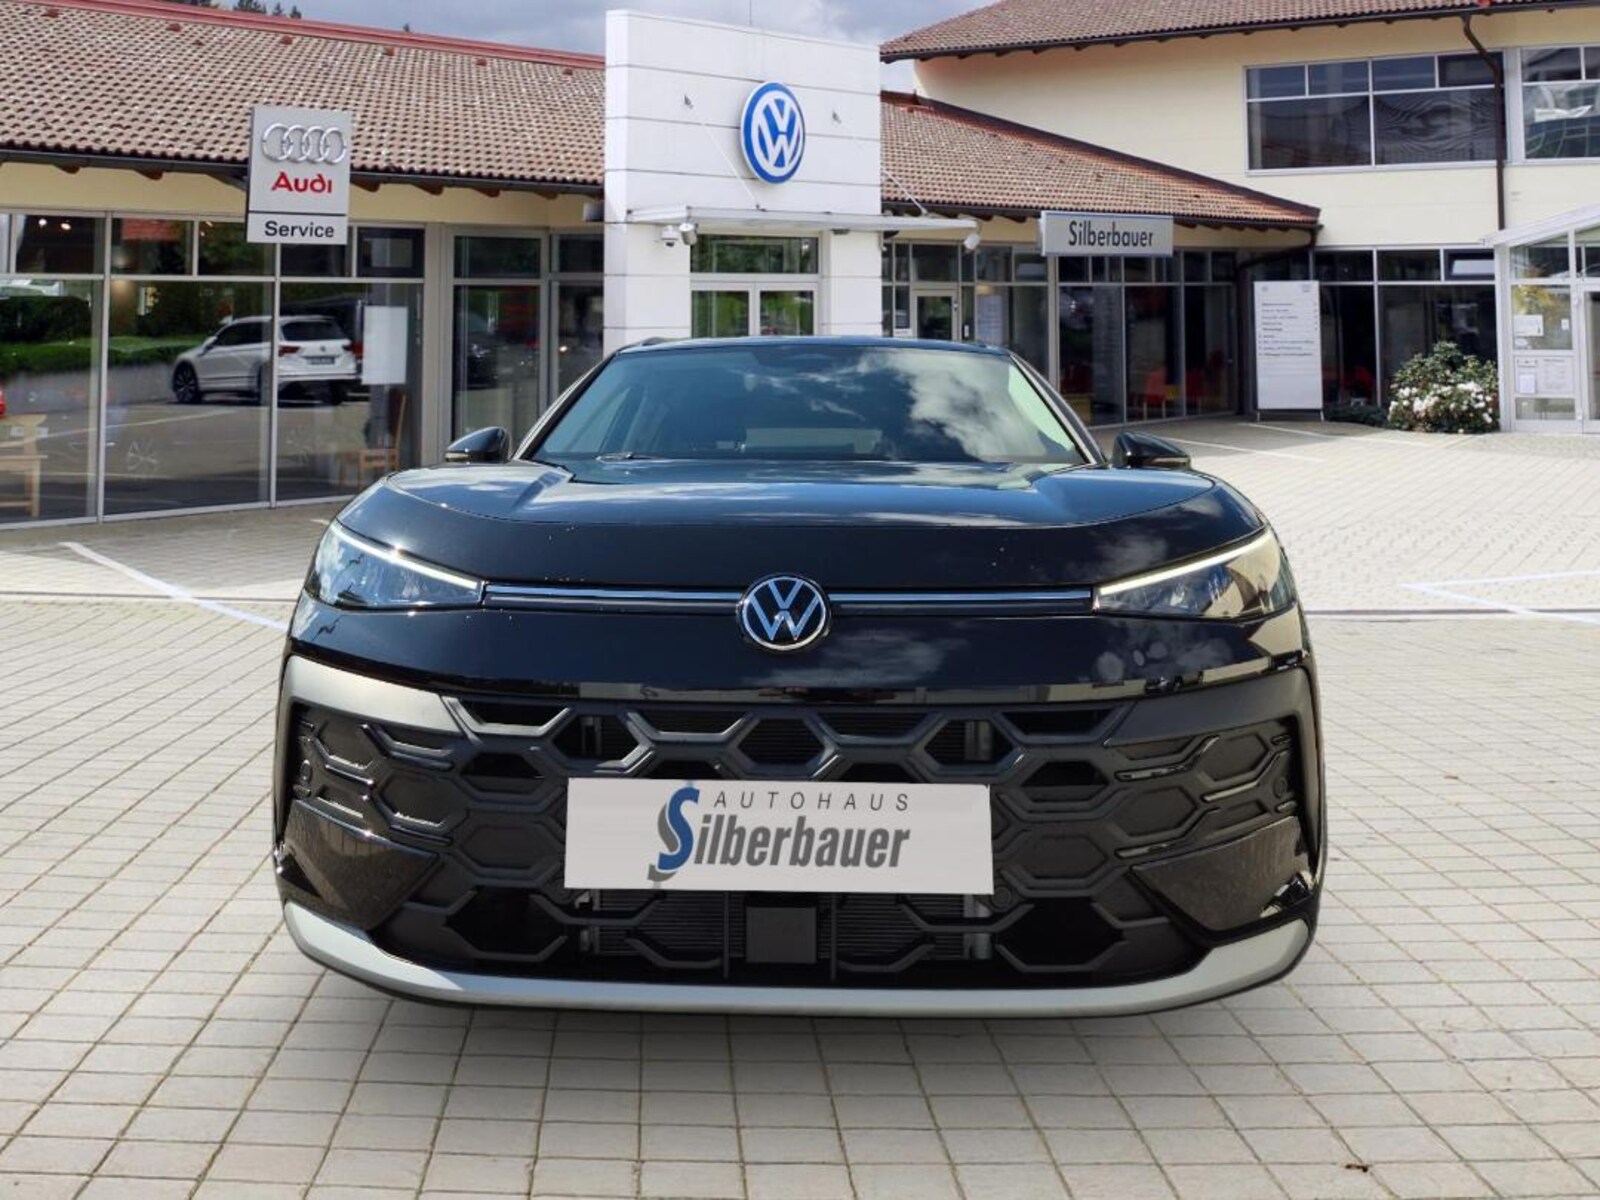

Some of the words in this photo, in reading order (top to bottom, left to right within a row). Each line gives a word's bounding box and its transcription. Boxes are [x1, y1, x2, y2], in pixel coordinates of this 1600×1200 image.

[271, 171, 333, 194] Audi
[264, 220, 335, 238] Service
[1068, 220, 1154, 247] Silberbauer
[714, 791, 910, 811] AUTOHAUS
[654, 785, 911, 876] Silberbauer
